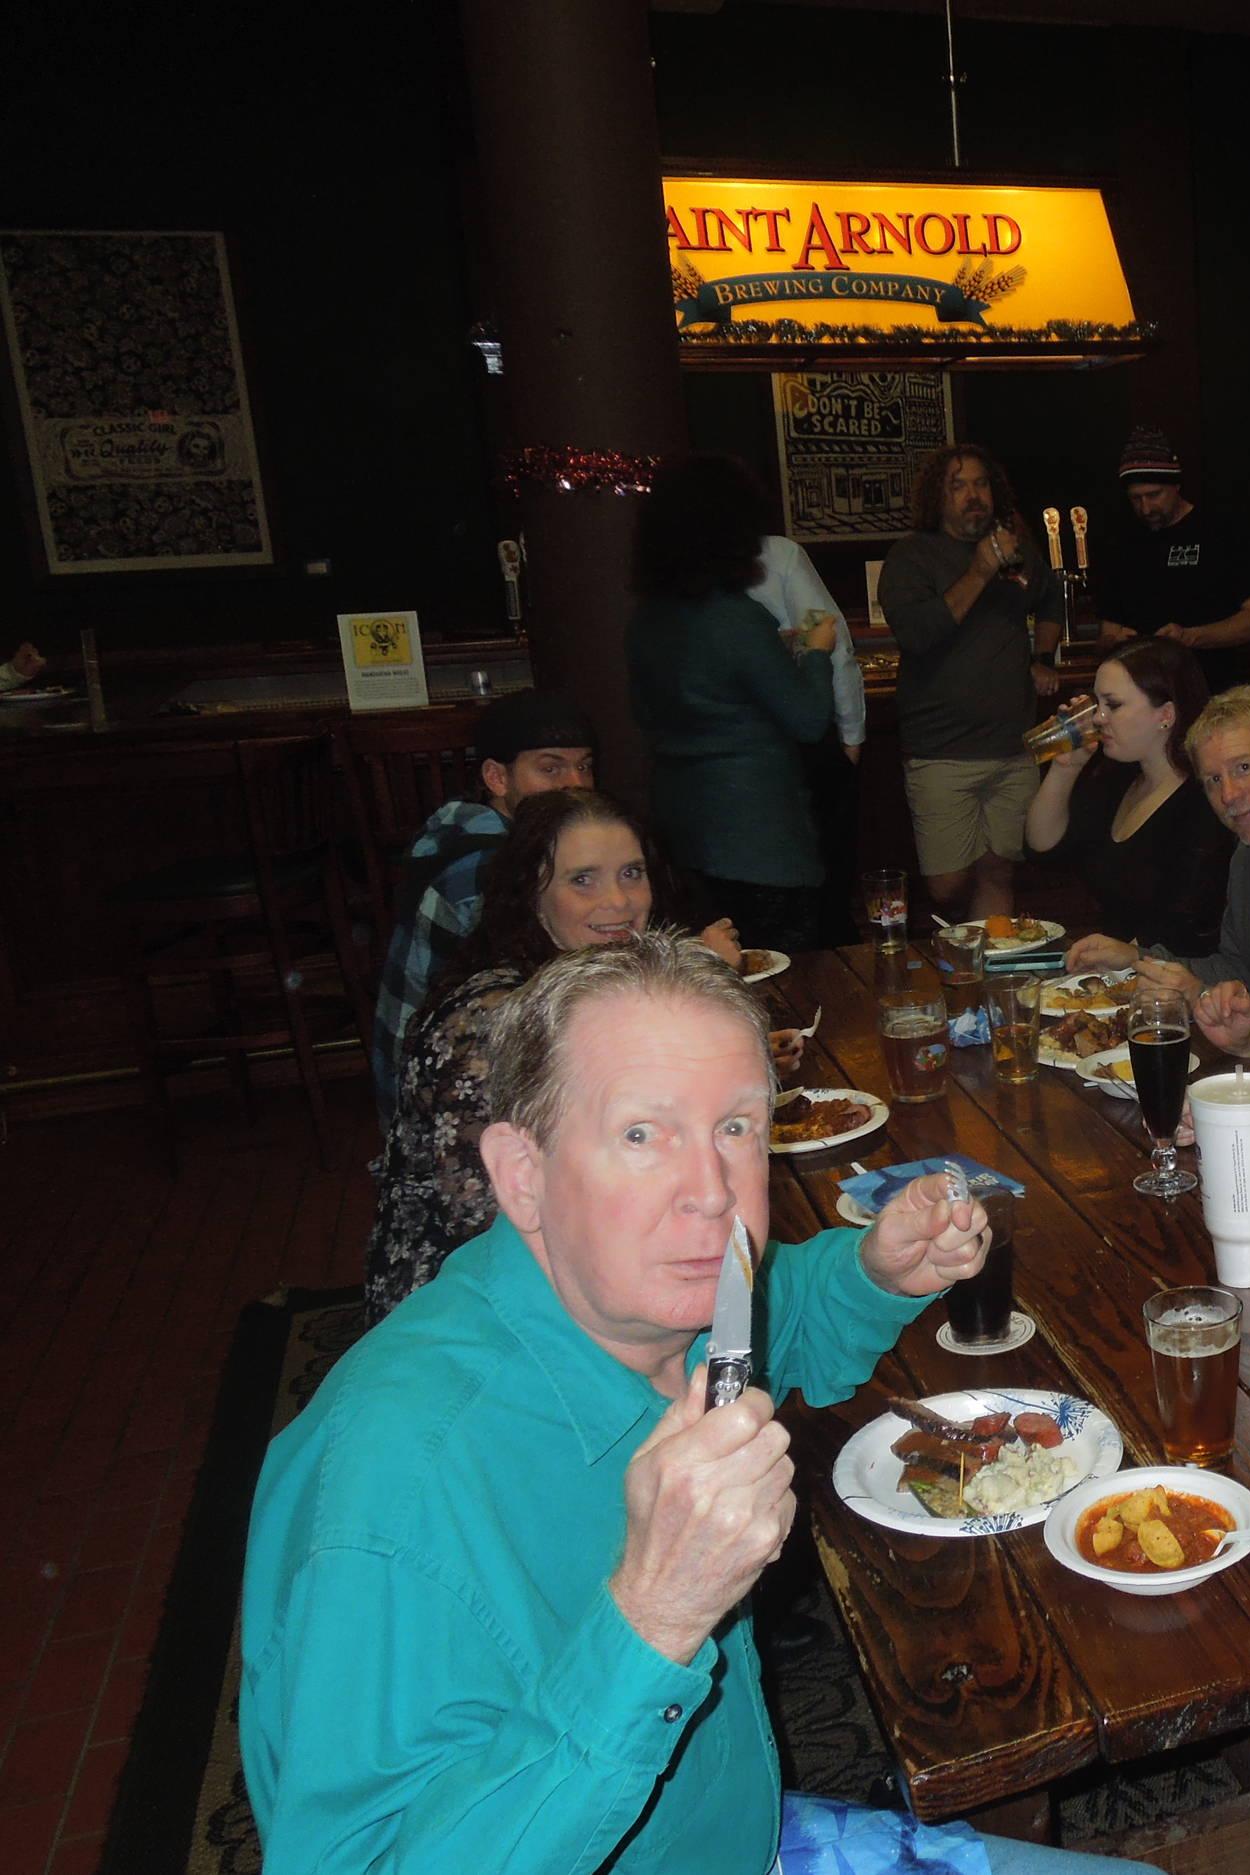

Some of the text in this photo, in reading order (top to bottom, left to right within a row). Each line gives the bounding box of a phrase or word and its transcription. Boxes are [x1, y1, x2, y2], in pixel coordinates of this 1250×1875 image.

[667, 202, 1022, 271] AINT ARNOLD
[714, 275, 946, 305] BREWING COMPANY
[807, 396, 881, 419] DON'T BE
[94, 422, 146, 436] CLASSIC
[811, 415, 881, 436] SCARED
